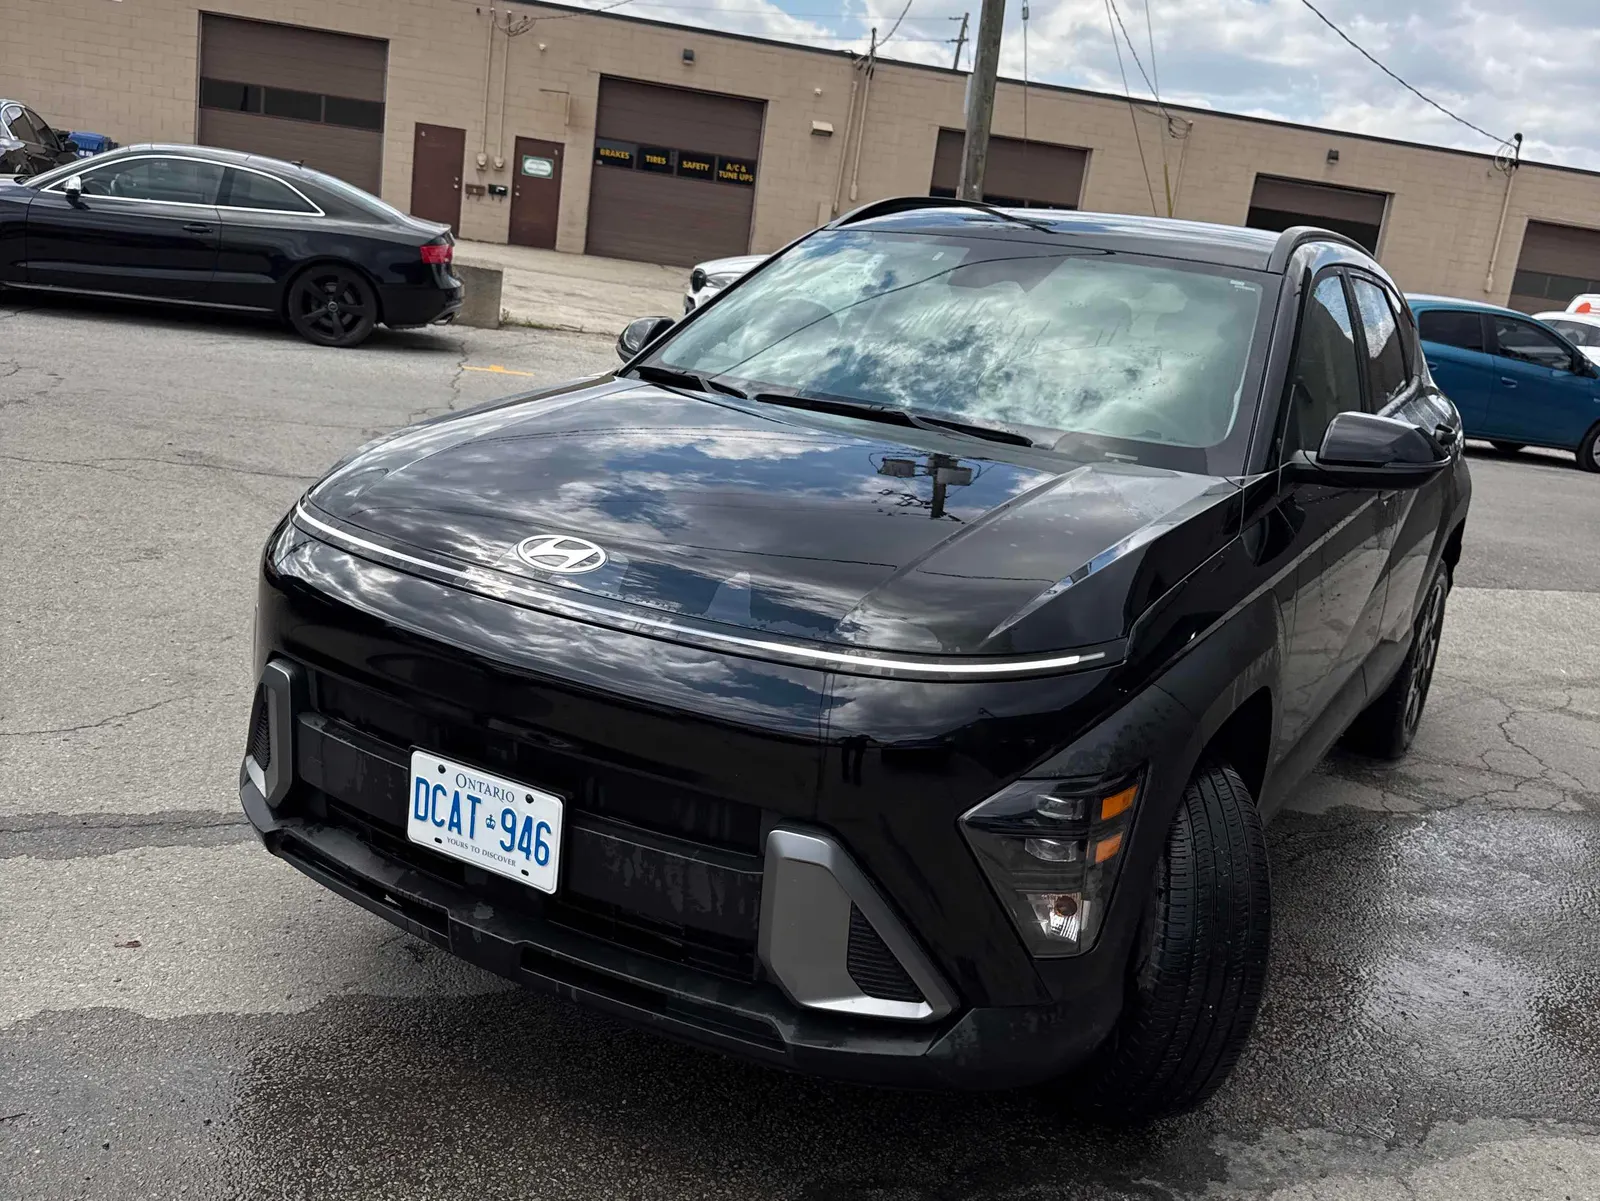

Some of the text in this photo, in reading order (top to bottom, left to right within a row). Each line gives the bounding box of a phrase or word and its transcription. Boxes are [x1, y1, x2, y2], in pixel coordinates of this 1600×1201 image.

[600, 148, 630, 159] BRAKES
[645, 154, 667, 165] TIRES
[682, 160, 710, 171] SAFETY
[726, 162, 740, 172] A/C
[719, 170, 754, 182] TUNE UPS
[455, 773, 515, 803] ONTARIO
[414, 776, 552, 866] DCAT 946
[446, 836, 516, 867] YOURS TO DISCOVER
